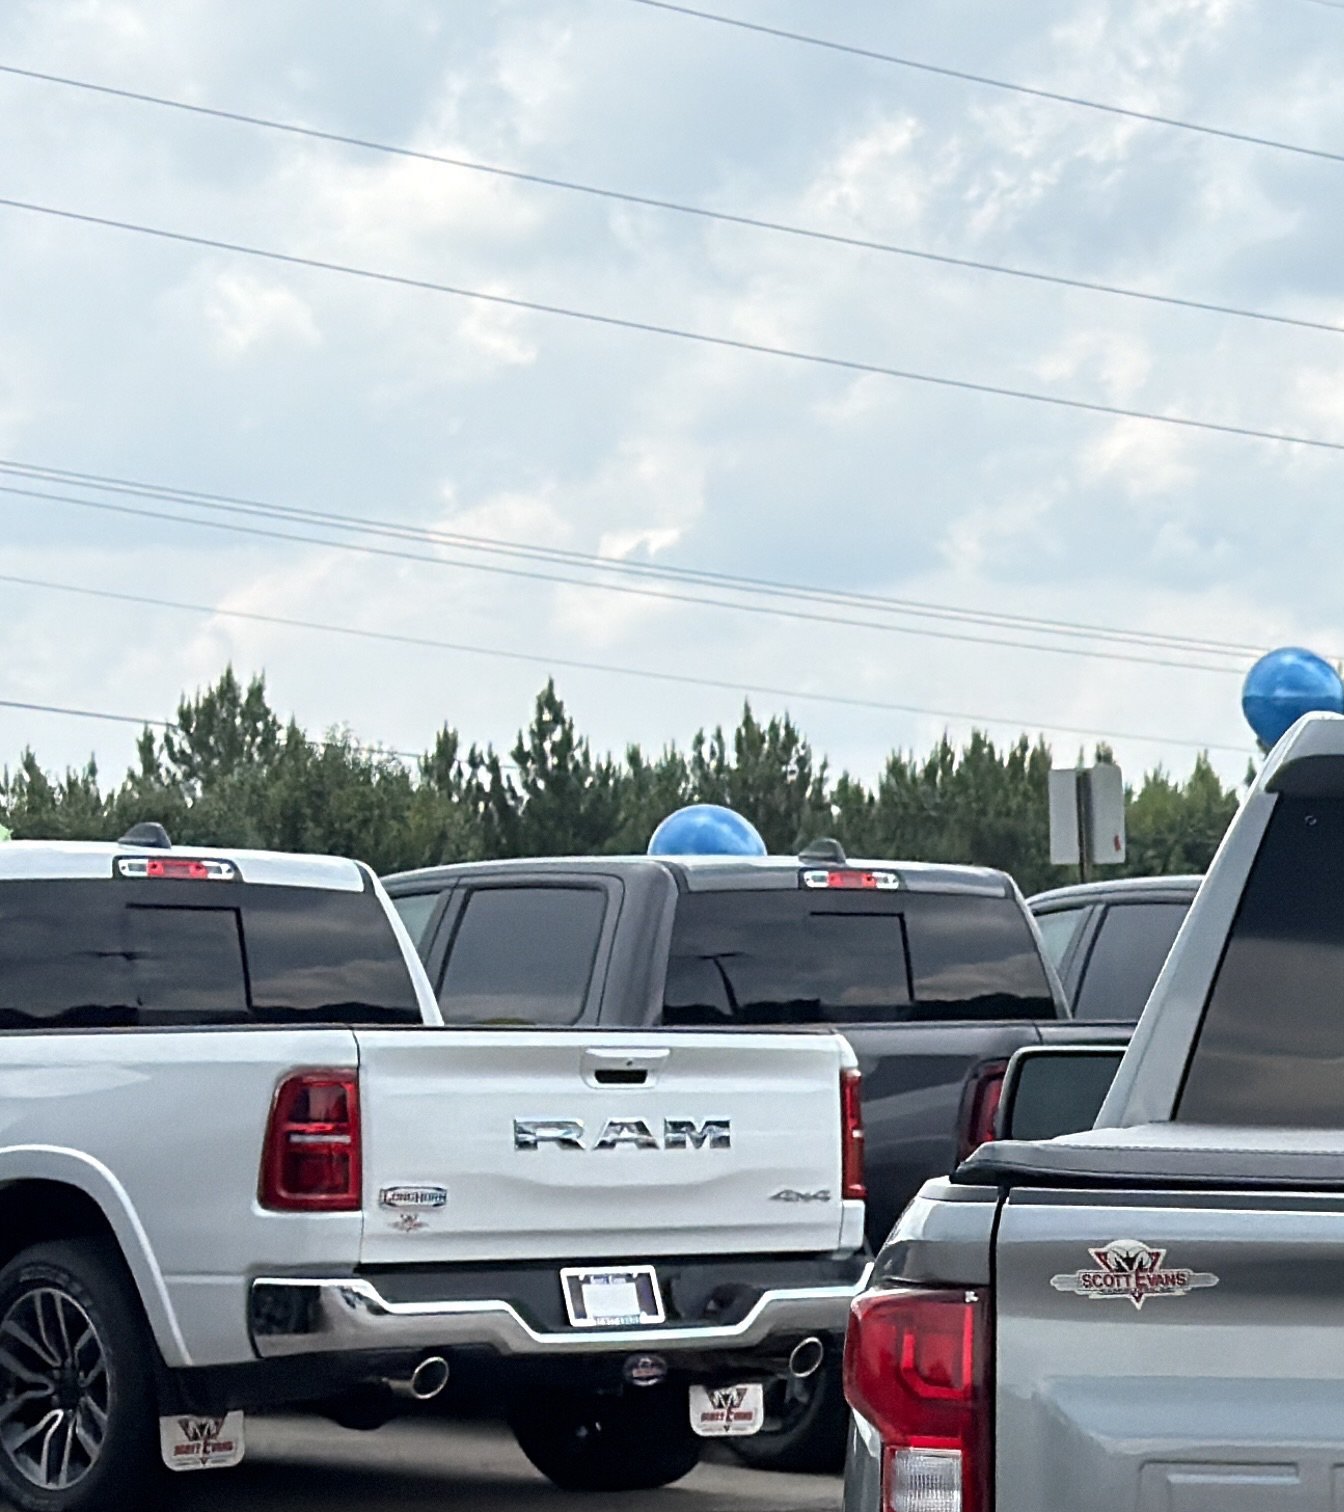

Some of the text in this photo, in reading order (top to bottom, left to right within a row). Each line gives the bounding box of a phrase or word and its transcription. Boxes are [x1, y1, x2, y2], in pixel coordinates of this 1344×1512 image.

[514, 1117, 731, 1151] RAM
[1081, 1267, 1188, 1290] SCOTT EVANS
